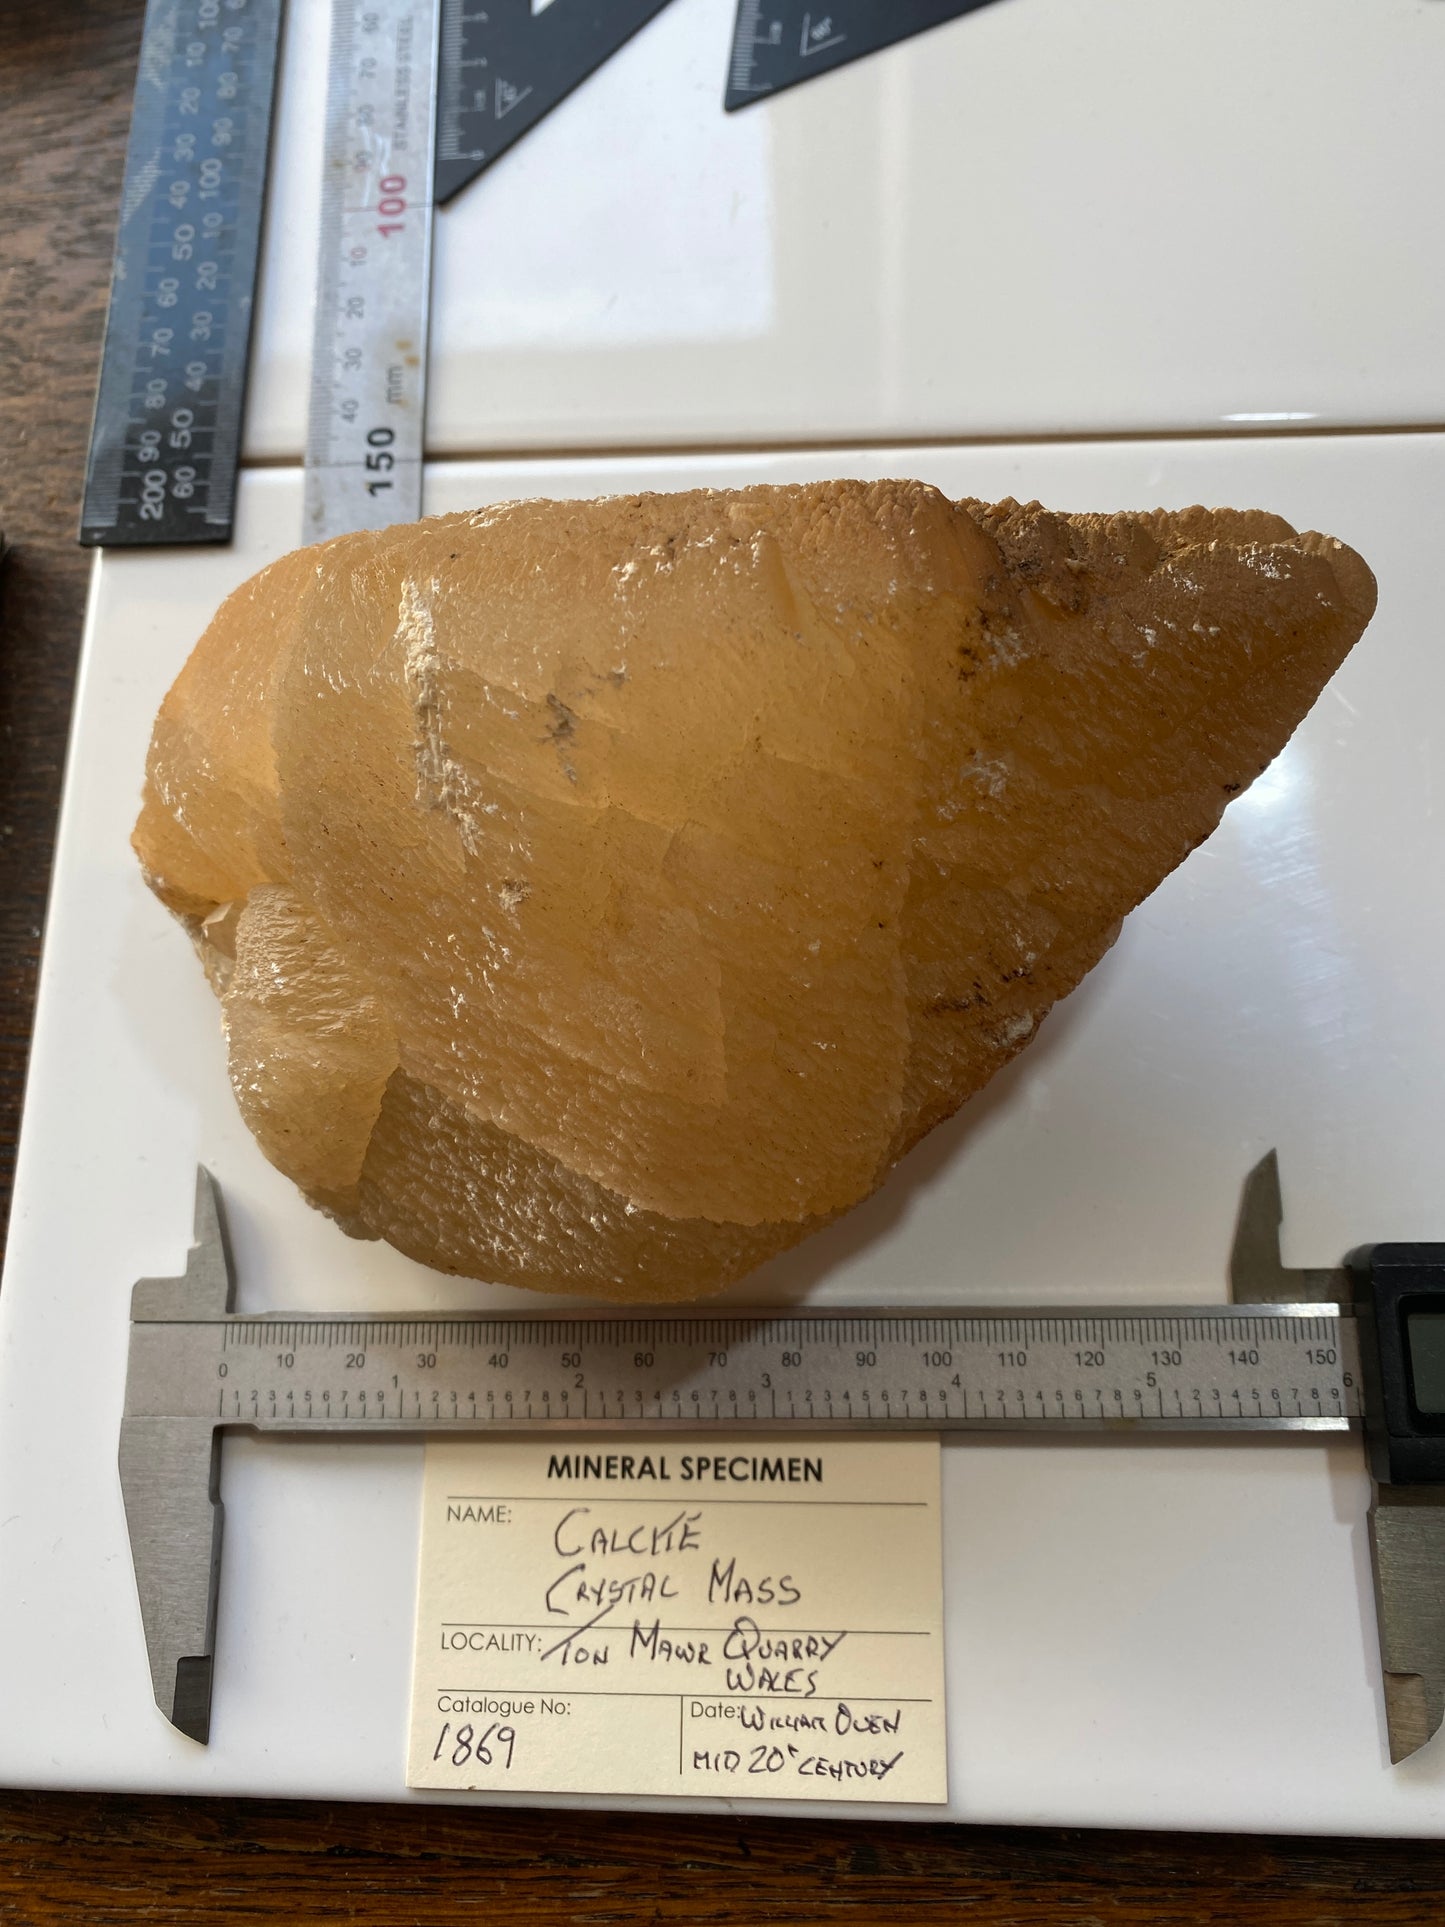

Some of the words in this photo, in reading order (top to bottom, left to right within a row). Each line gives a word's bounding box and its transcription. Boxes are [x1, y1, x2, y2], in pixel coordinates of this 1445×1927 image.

[186, 41, 206, 67] 10
[180, 87, 201, 115] 20
[174, 133, 196, 162] 30
[211, 117, 233, 147] 90
[169, 180, 191, 209] 40
[198, 158, 222, 200] 100
[376, 174, 407, 239] 100
[202, 212, 223, 239] 10
[172, 223, 195, 261] 50
[350, 247, 368, 267] 10
[196, 261, 218, 291] 20
[157, 277, 180, 308] 60
[345, 296, 365, 319] 20
[190, 310, 213, 342] 30
[151, 327, 174, 357] 70
[343, 348, 363, 371] 30
[184, 360, 207, 392] 40
[385, 366, 403, 404] mm
[145, 378, 168, 409] 80
[339, 399, 360, 423] 40
[169, 408, 194, 449] 50
[137, 429, 162, 463] 90
[365, 427, 395, 497] 150
[140, 469, 167, 520] 200
[172, 465, 196, 499] 60
[217, 1362, 229, 1379] 0
[276, 1352, 295, 1370] 10
[344, 1352, 366, 1371] 20
[416, 1352, 437, 1370] 30
[487, 1352, 509, 1369] 40
[560, 1352, 582, 1369] 50
[633, 1351, 655, 1368] 60
[707, 1351, 728, 1368] 70
[780, 1351, 802, 1368] 80
[855, 1351, 877, 1368] 90
[921, 1350, 953, 1368] 100
[997, 1350, 1028, 1368] 110
[1073, 1350, 1106, 1368] 120
[1151, 1349, 1183, 1367] 130
[1227, 1349, 1260, 1366] 140
[1304, 1348, 1337, 1366] 150
[234, 1389, 240, 1402] 1
[250, 1389, 259, 1402] 2
[268, 1389, 277, 1402] 3
[285, 1389, 294, 1402] 4
[303, 1389, 312, 1402] 5
[322, 1389, 331, 1402] 6
[340, 1389, 349, 1402] 7
[357, 1389, 367, 1402] 8
[376, 1389, 385, 1402] 9
[414, 1390, 420, 1402] 1
[431, 1390, 440, 1402] 2
[450, 1390, 459, 1402] 3
[467, 1390, 476, 1402] 4
[486, 1390, 495, 1402] 5
[504, 1390, 513, 1402] 6
[524, 1390, 532, 1402] 7
[541, 1390, 550, 1402] 8
[560, 1390, 569, 1402] 9
[599, 1389, 605, 1402] 1
[616, 1389, 624, 1402] 2
[635, 1389, 643, 1402] 3
[653, 1389, 661, 1402] 4
[672, 1389, 681, 1402] 5
[690, 1389, 700, 1402] 6
[710, 1389, 719, 1402] 7
[728, 1389, 737, 1402] 8
[748, 1389, 757, 1402] 9
[786, 1389, 793, 1402] 1
[804, 1389, 813, 1402] 2
[824, 1389, 832, 1402] 3
[842, 1389, 851, 1402] 4
[861, 1389, 870, 1402] 5
[880, 1389, 890, 1402] 6
[900, 1389, 909, 1402] 7
[918, 1389, 928, 1402] 8
[938, 1389, 948, 1402] 9
[978, 1388, 985, 1401] 1
[996, 1388, 1005, 1401] 2
[1016, 1388, 1025, 1401] 3
[1035, 1388, 1044, 1401] 4
[1055, 1388, 1064, 1401] 5
[1074, 1388, 1084, 1401] 6
[1094, 1388, 1103, 1401] 7
[1113, 1388, 1123, 1401] 8
[1132, 1388, 1143, 1401] 9
[1173, 1387, 1180, 1400] 1
[1191, 1387, 1201, 1400] 2
[1211, 1387, 1221, 1400] 3
[1230, 1387, 1241, 1400] 4
[1251, 1387, 1260, 1400] 5
[1270, 1387, 1281, 1400] 6
[1290, 1387, 1299, 1400] 7
[1309, 1387, 1320, 1400] 8
[1329, 1387, 1340, 1400] 9
[391, 1373, 399, 1390] 1
[574, 1372, 585, 1389] 2
[761, 1372, 772, 1390] 3
[950, 1372, 962, 1389] 4
[1145, 1371, 1158, 1389] 5
[1342, 1371, 1354, 1388] 6
[547, 1454, 671, 1480] MINERAL
[680, 1457, 824, 1483] SPECIMEN
[447, 1505, 512, 1524] NAME:
[546, 1563, 679, 1615] CRYSTAL
[708, 1557, 801, 1605] MASS
[441, 1631, 542, 1652] LOCALITY:
[541, 1604, 614, 1666] TON
[630, 1619, 712, 1665] MAWR
[723, 1616, 848, 1661] QUARRY
[726, 1662, 818, 1697] WALES
[437, 1695, 535, 1718] Catalogue
[540, 1698, 571, 1715] No:
[691, 1701, 741, 1719] Date:
[835, 1703, 901, 1735] OWEN
[433, 1722, 516, 1769] 1869
[693, 1751, 740, 1773] MID
[798, 1750, 905, 1781] CENTURY
